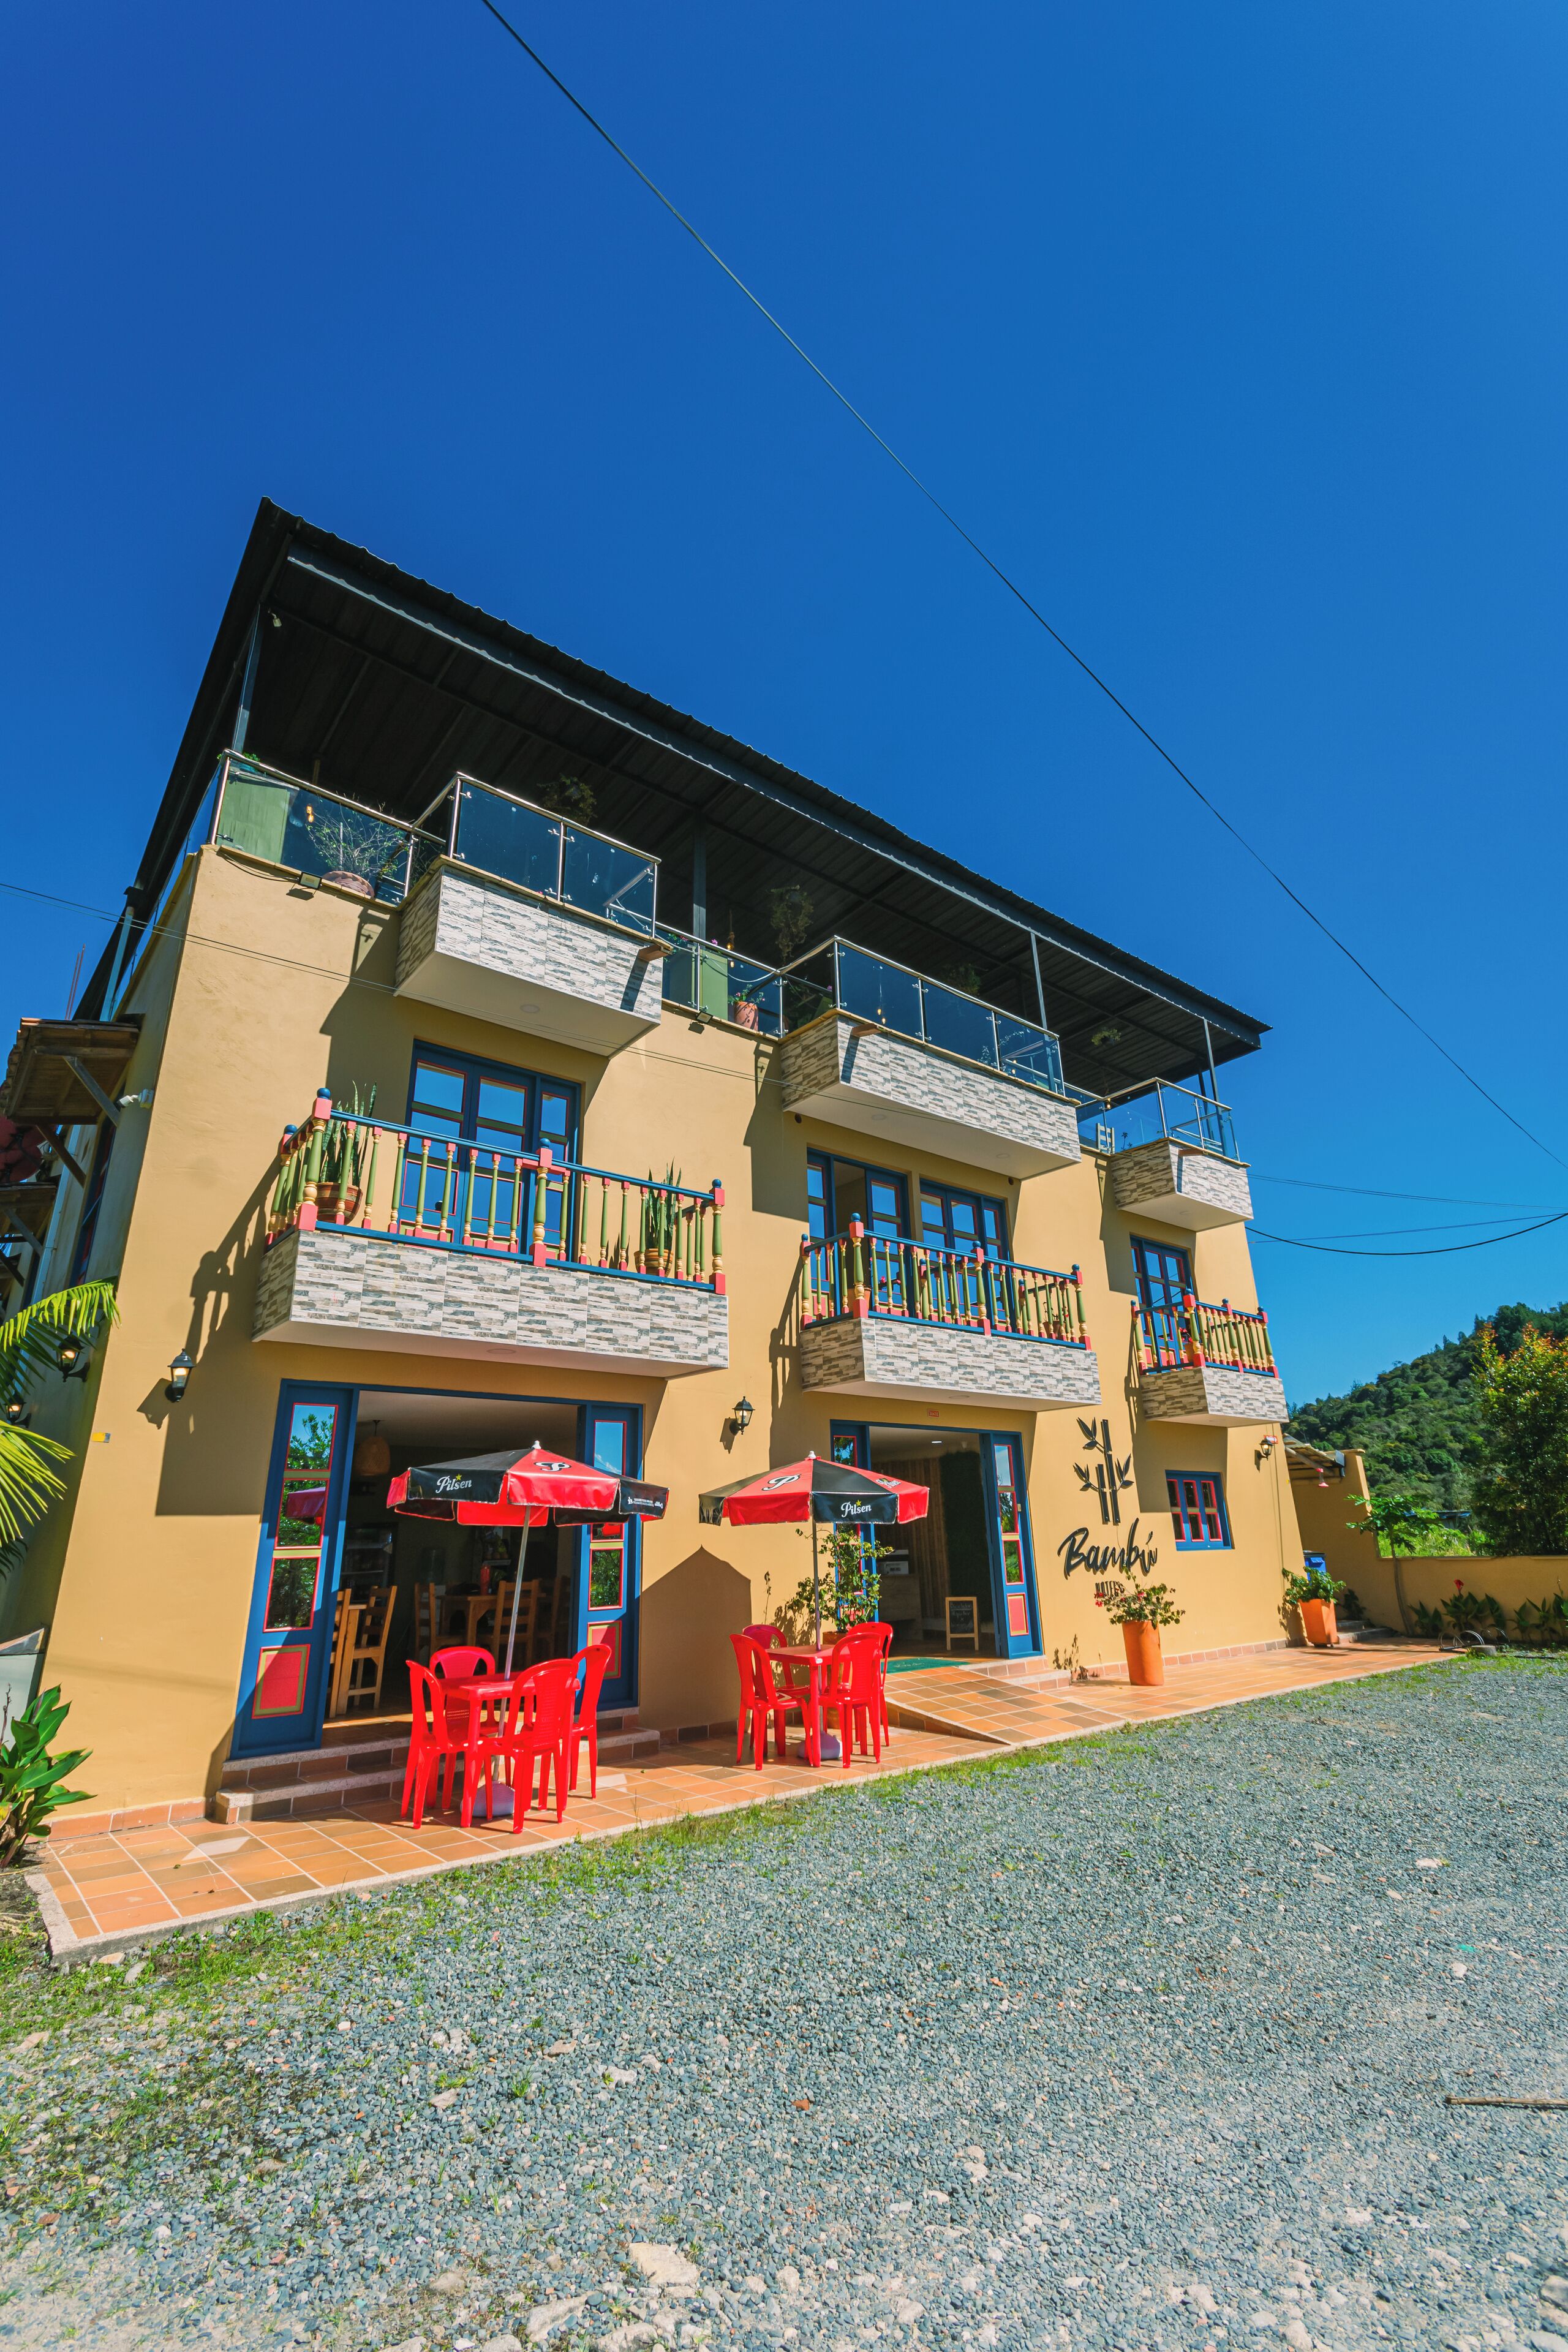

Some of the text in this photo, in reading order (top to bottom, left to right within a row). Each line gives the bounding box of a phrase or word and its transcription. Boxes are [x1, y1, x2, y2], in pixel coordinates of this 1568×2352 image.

[435, 1476, 472, 1493] Pilsen
[762, 1474, 801, 1491] P
[840, 1501, 872, 1518] Pilsen
[1057, 1517, 1158, 1577] Bambú
